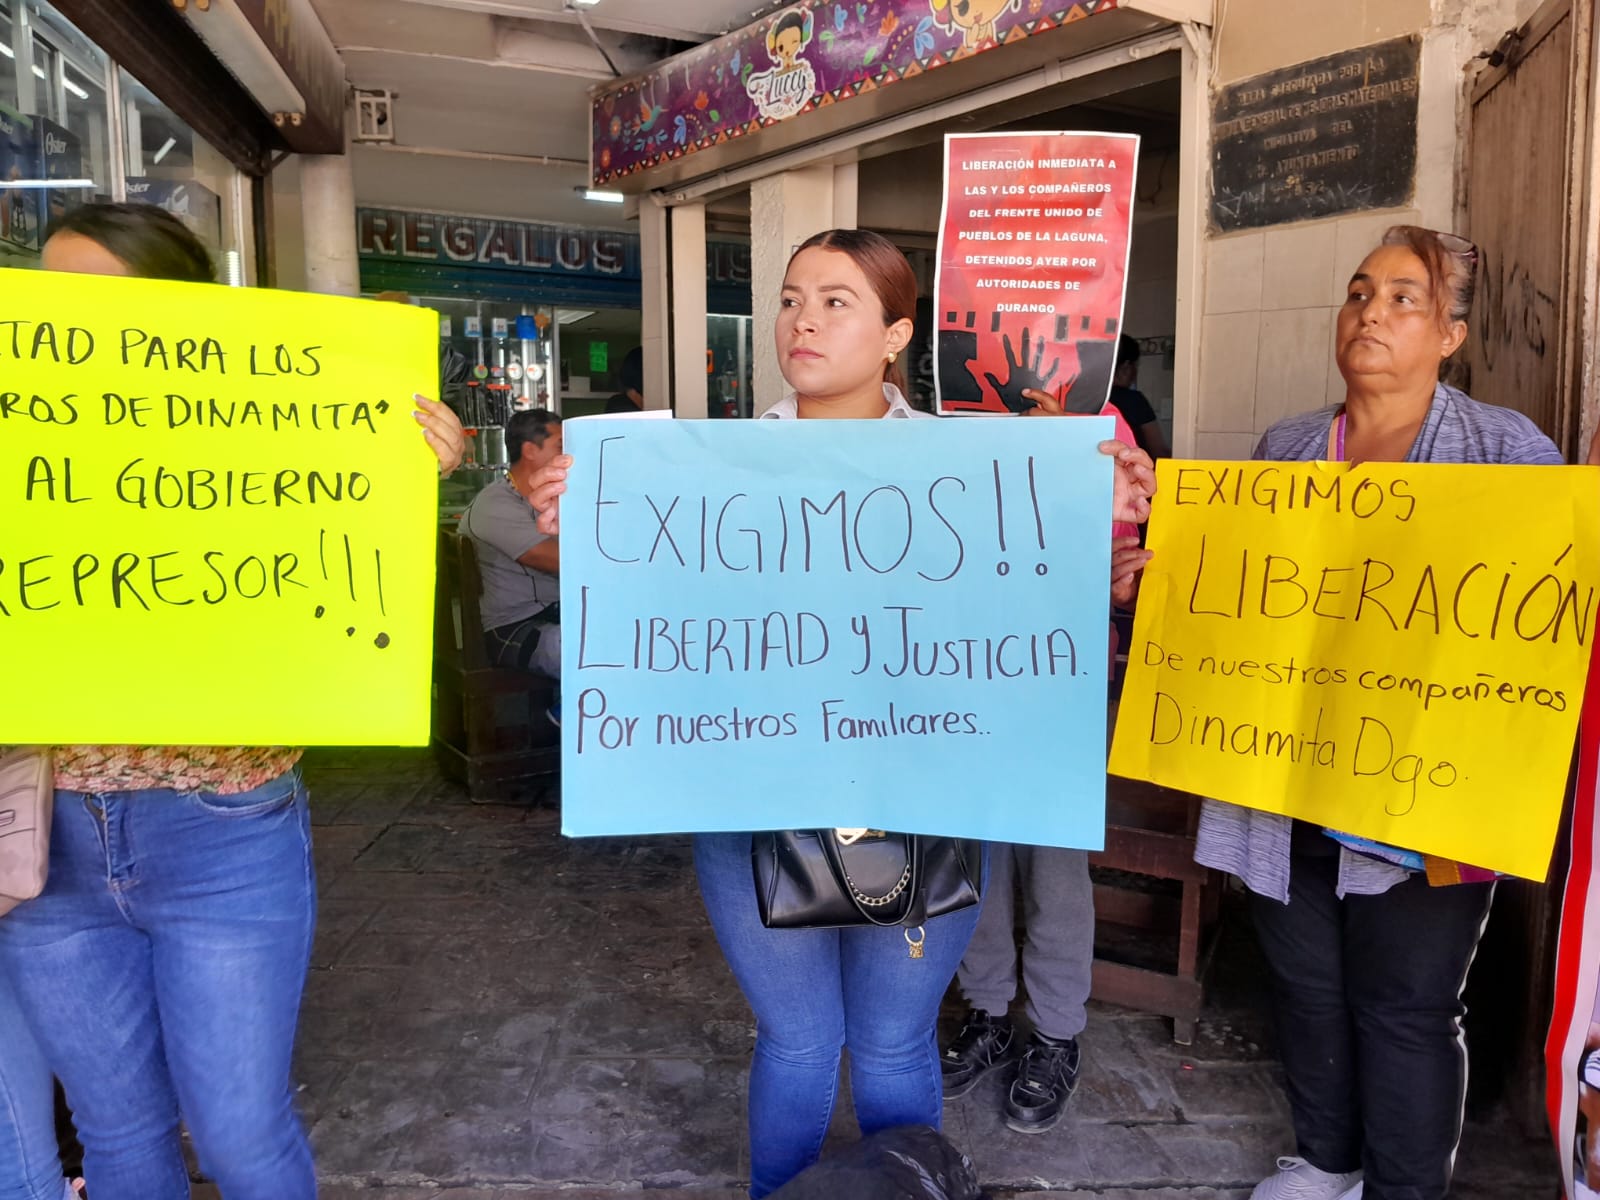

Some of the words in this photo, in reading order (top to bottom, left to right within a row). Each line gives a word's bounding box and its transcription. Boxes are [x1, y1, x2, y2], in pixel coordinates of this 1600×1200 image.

[1338, 63, 1362, 79] POR
[962, 158, 1034, 171] LIBERACIÓN
[1038, 158, 1105, 169] INMEDIATA
[1108, 159, 1117, 169] A
[964, 185, 987, 196] LAS
[991, 185, 999, 195] Y
[1002, 184, 1025, 195] LOS
[1028, 183, 1112, 194] COMPAÑEROS
[969, 209, 991, 218] DEL
[995, 208, 1041, 217] FRENTE
[1044, 208, 1083, 217] UNIDO
[1086, 208, 1104, 217] DE
[357, 214, 623, 274] REGALOS
[958, 231, 1013, 241] PUEBLOS
[1016, 231, 1032, 241] DE
[1035, 231, 1051, 241] LA
[1054, 232, 1108, 244] LAGUNA,
[965, 255, 1033, 266] DETENIDOS
[1035, 256, 1068, 266] AYER
[1071, 257, 1097, 267] POR
[976, 279, 1061, 290] AUTORIDADES
[1064, 281, 1081, 291] DE
[996, 303, 1056, 314] DURANGO
[120, 329, 228, 374] PARA
[249, 344, 323, 376] LOS
[102, 392, 153, 427] DE
[26, 456, 93, 503] AL
[115, 457, 371, 511] GOBIERNO
[1175, 467, 1416, 522] EXIGIMOS
[577, 585, 829, 674] LIBERTAD
[1144, 641, 1184, 672] De
[1198, 656, 1347, 685] nuestros
[1358, 672, 1567, 712] compañeros
[577, 687, 635, 754] Por
[656, 706, 798, 746] nuestros
[1149, 691, 1336, 769] Dinamita
